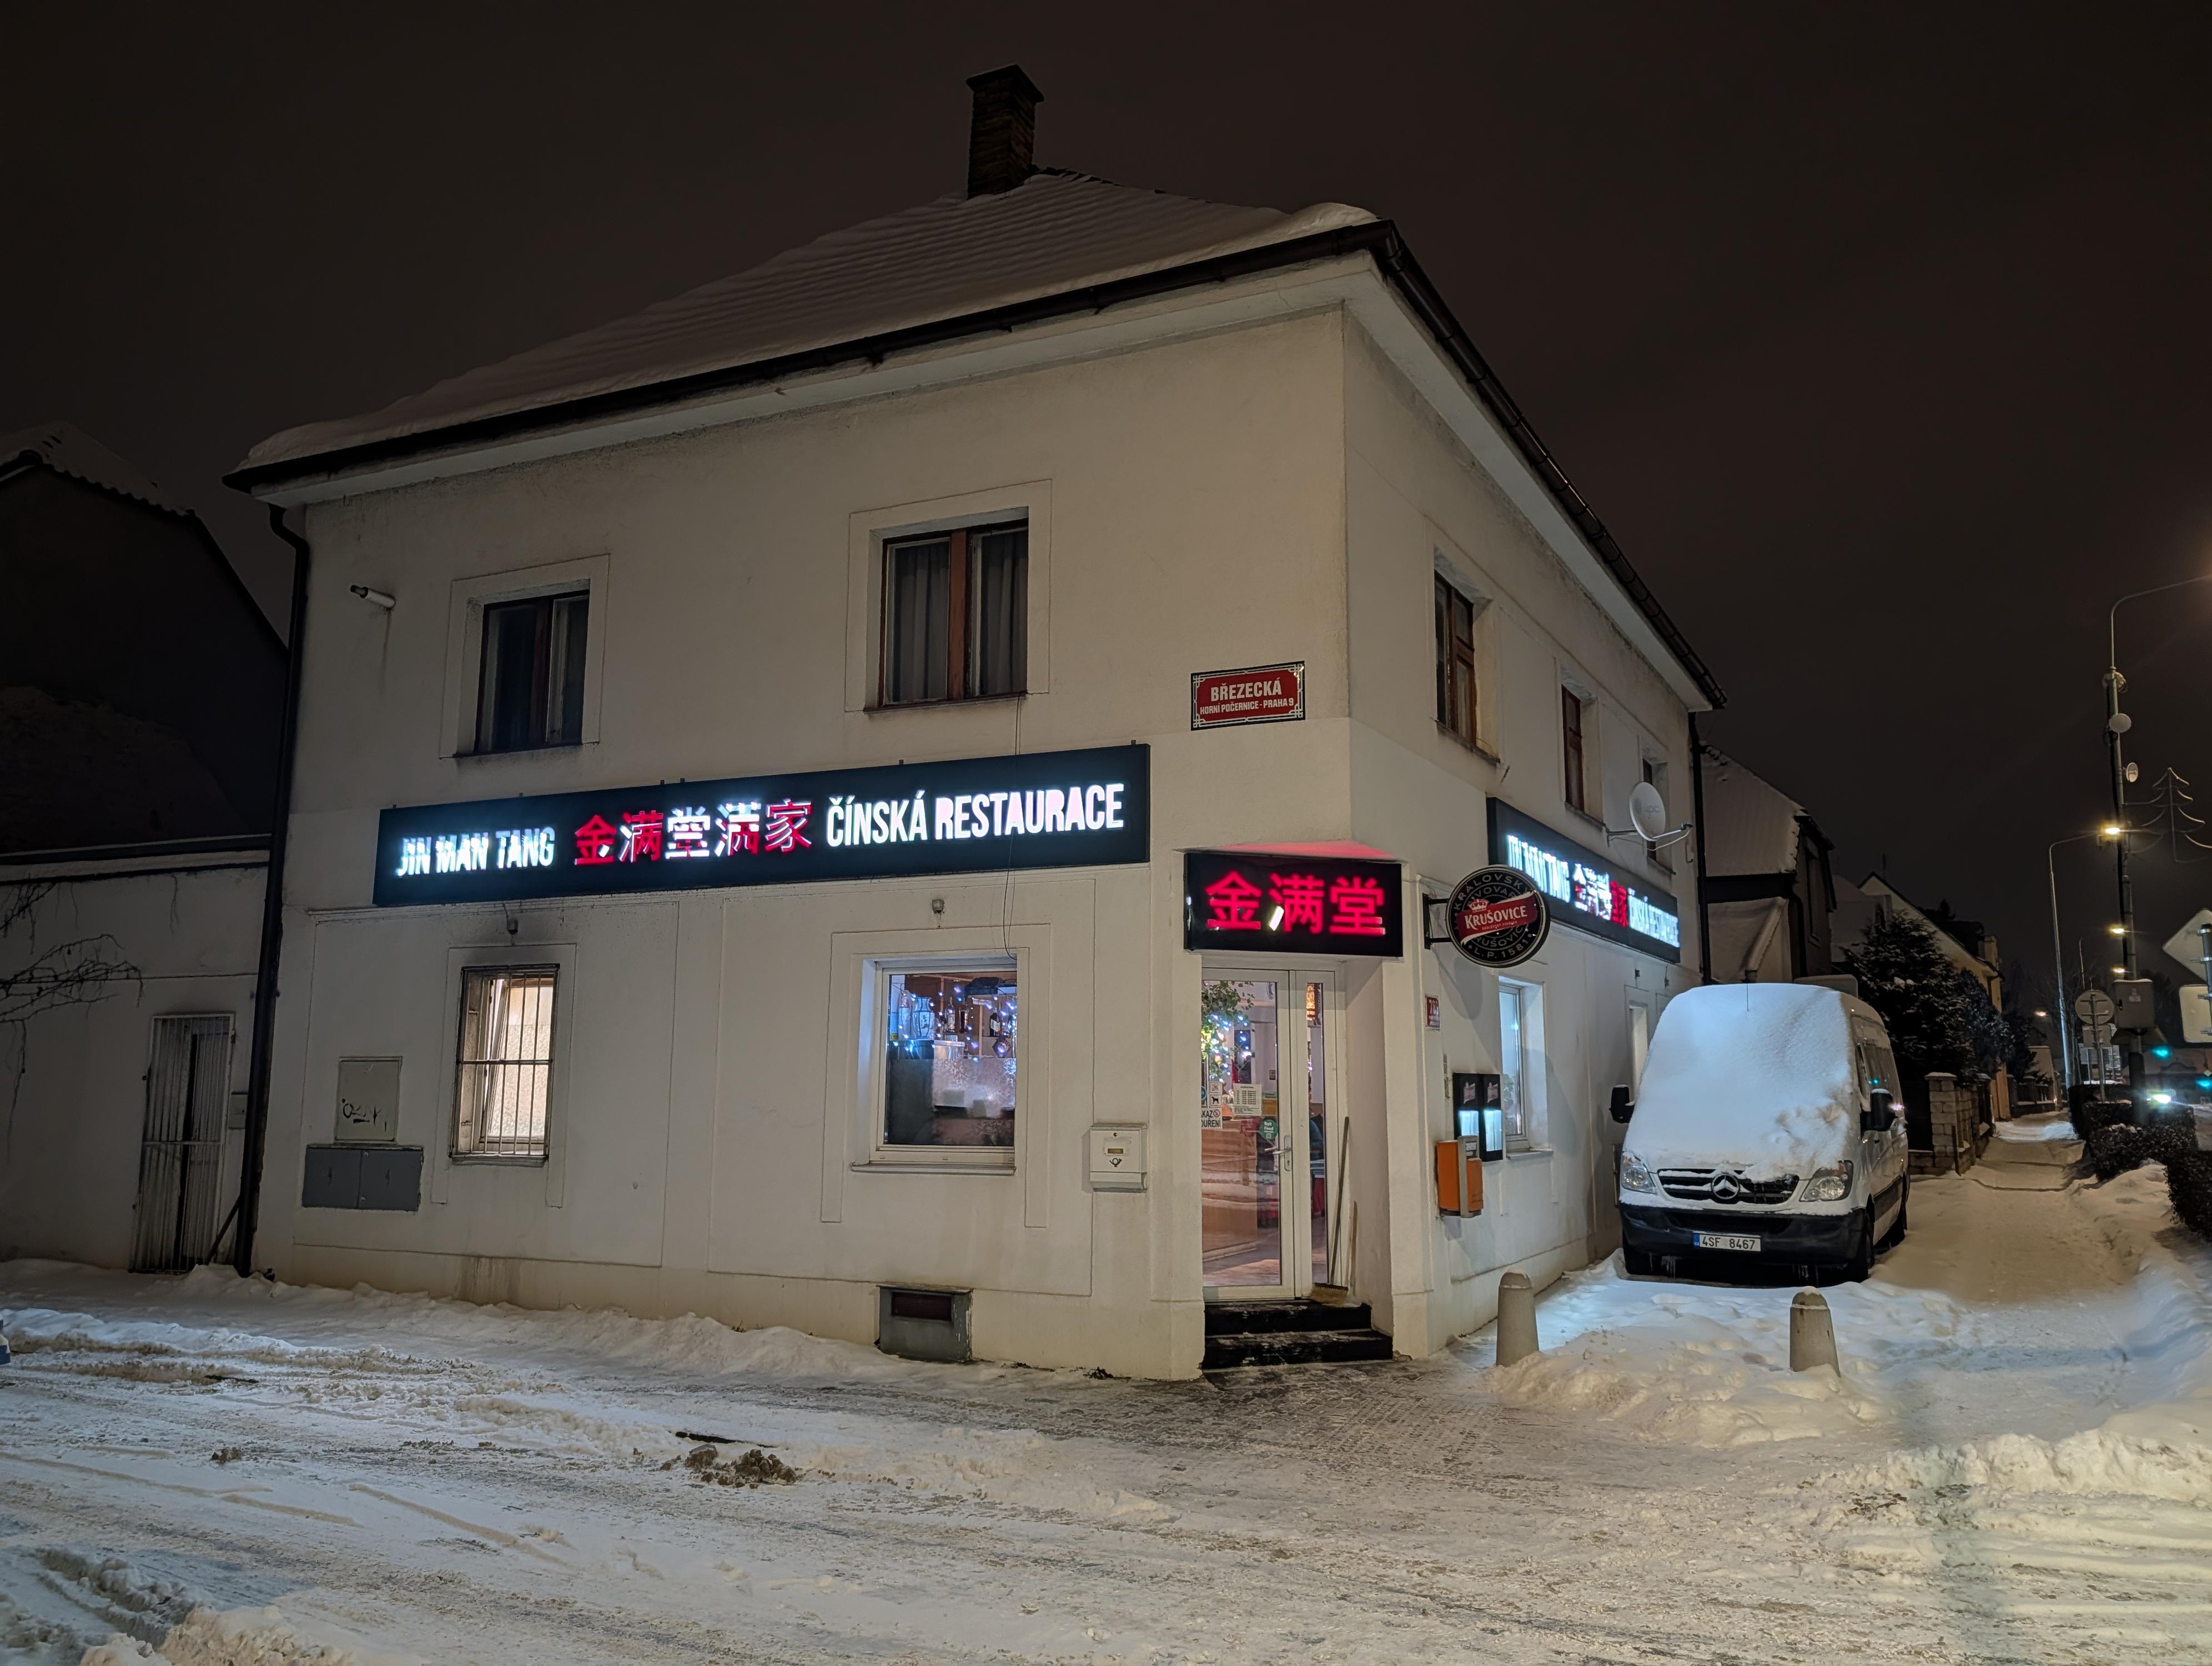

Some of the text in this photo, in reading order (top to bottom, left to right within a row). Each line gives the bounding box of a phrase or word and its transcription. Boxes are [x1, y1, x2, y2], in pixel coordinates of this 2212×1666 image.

[1211, 677, 1282, 702] BŘEZECKÁ
[1200, 702, 1220, 715] HORNÍ
[1222, 700, 1259, 713] POČERNICE
[1263, 698, 1288, 709] PRAHA
[1289, 697, 1294, 706] 9
[826, 782, 1124, 847] ČÍNSKÁ RESTAURACE
[396, 826, 555, 877] JIN MAN TANG
[1205, 870, 1386, 936] 金满堂
[1464, 906, 1528, 930] KRUŠOVICE
[1501, 939, 1529, 958] 1581
[1702, 1236, 1756, 1250] 4SF 8467
